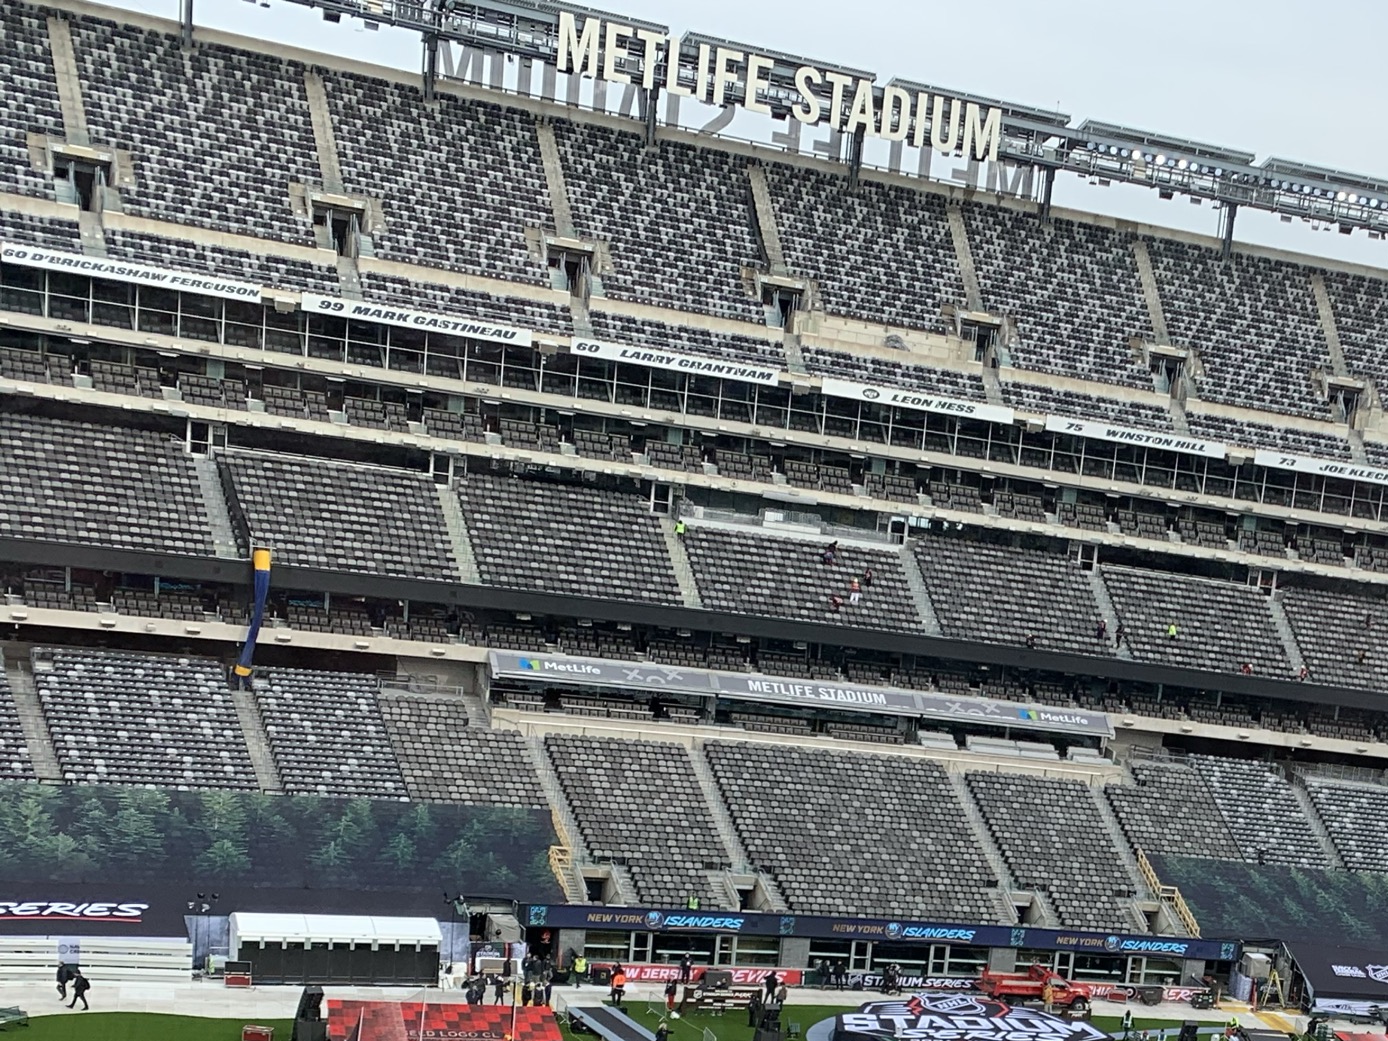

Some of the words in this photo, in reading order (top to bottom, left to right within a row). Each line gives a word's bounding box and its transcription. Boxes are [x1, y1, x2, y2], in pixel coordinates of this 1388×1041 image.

[557, 12, 774, 115] METLIFE
[792, 66, 1002, 161] STADIUM
[3, 247, 28, 259] 60
[31, 252, 168, 283] D'BRICKASHAW
[169, 276, 261, 299] FERGUSON
[318, 300, 345, 312] 99
[352, 305, 410, 323] MARK
[413, 315, 518, 341] GASTINEAU
[576, 342, 600, 354] 60
[619, 349, 675, 367] LARRY
[678, 359, 774, 382] GRANTHAM
[890, 394, 935, 409] LEON
[935, 400, 976, 414] HESS
[1065, 422, 1083, 432] 75
[1105, 428, 1174, 448] WINSTON
[1174, 440, 1207, 453] HILL
[1278, 457, 1296, 467] 73
[1318, 464, 1348, 474] JOE
[543, 660, 601, 675] MetLife
[748, 679, 815, 699] METLIFE
[818, 686, 888, 705] STADIUM
[1040, 711, 1089, 725] MetLife
[587, 912, 612, 923] NEW
[613, 914, 643, 924] YORK
[663, 915, 744, 929] ISLANDERS
[832, 923, 855, 933] NEW
[856, 925, 885, 935] YORK
[902, 927, 976, 941] ISLANDERS
[1056, 936, 1078, 945] NEW
[1079, 938, 1104, 948] YORK
[1121, 940, 1188, 954] ISLANDERS
[863, 975, 923, 988] STIUM
[922, 978, 974, 989] SERIES
[936, 998, 969, 1010] NHL
[842, 1013, 1107, 1041] STADIUM
